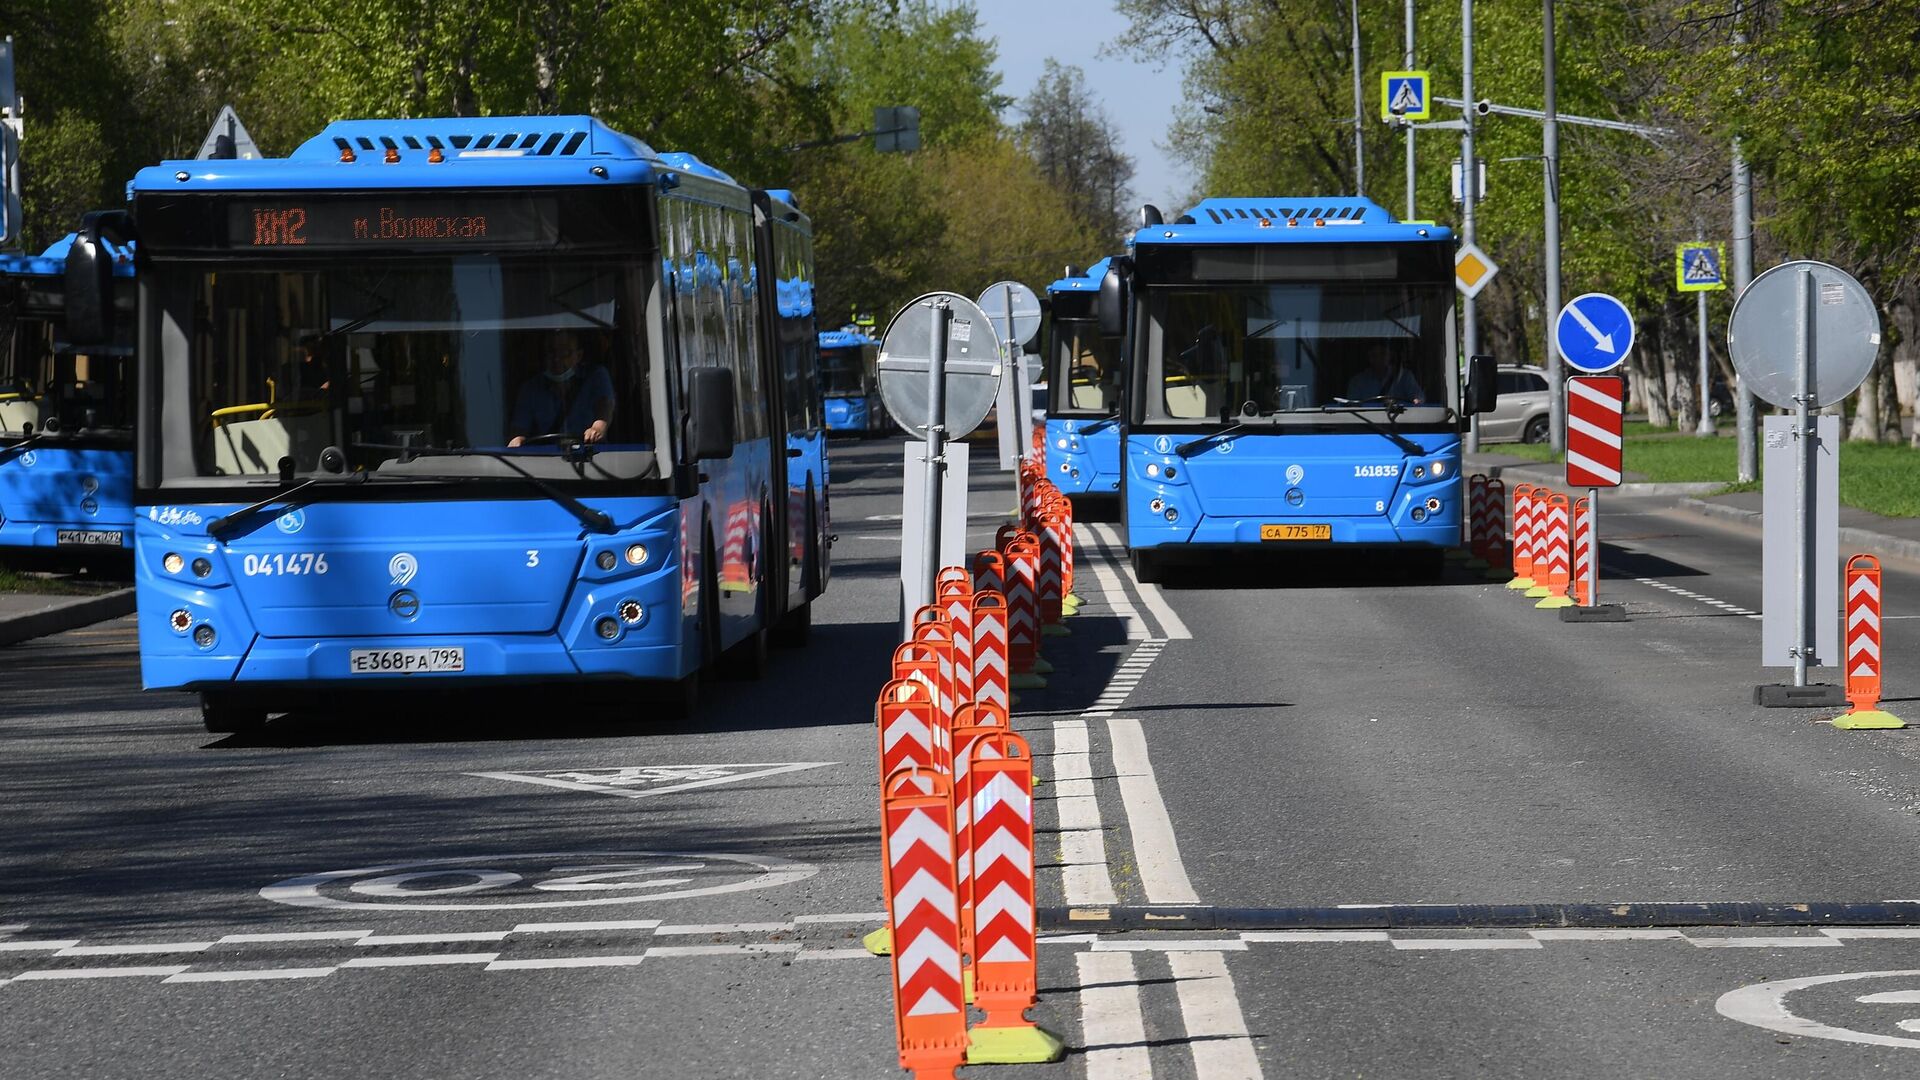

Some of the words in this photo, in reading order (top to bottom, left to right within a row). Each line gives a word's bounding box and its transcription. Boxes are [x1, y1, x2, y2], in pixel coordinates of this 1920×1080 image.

[1354, 465, 1399, 477] 161835
[1375, 500, 1384, 512] 8
[243, 553, 329, 576] 041476
[526, 550, 539, 568] 3
